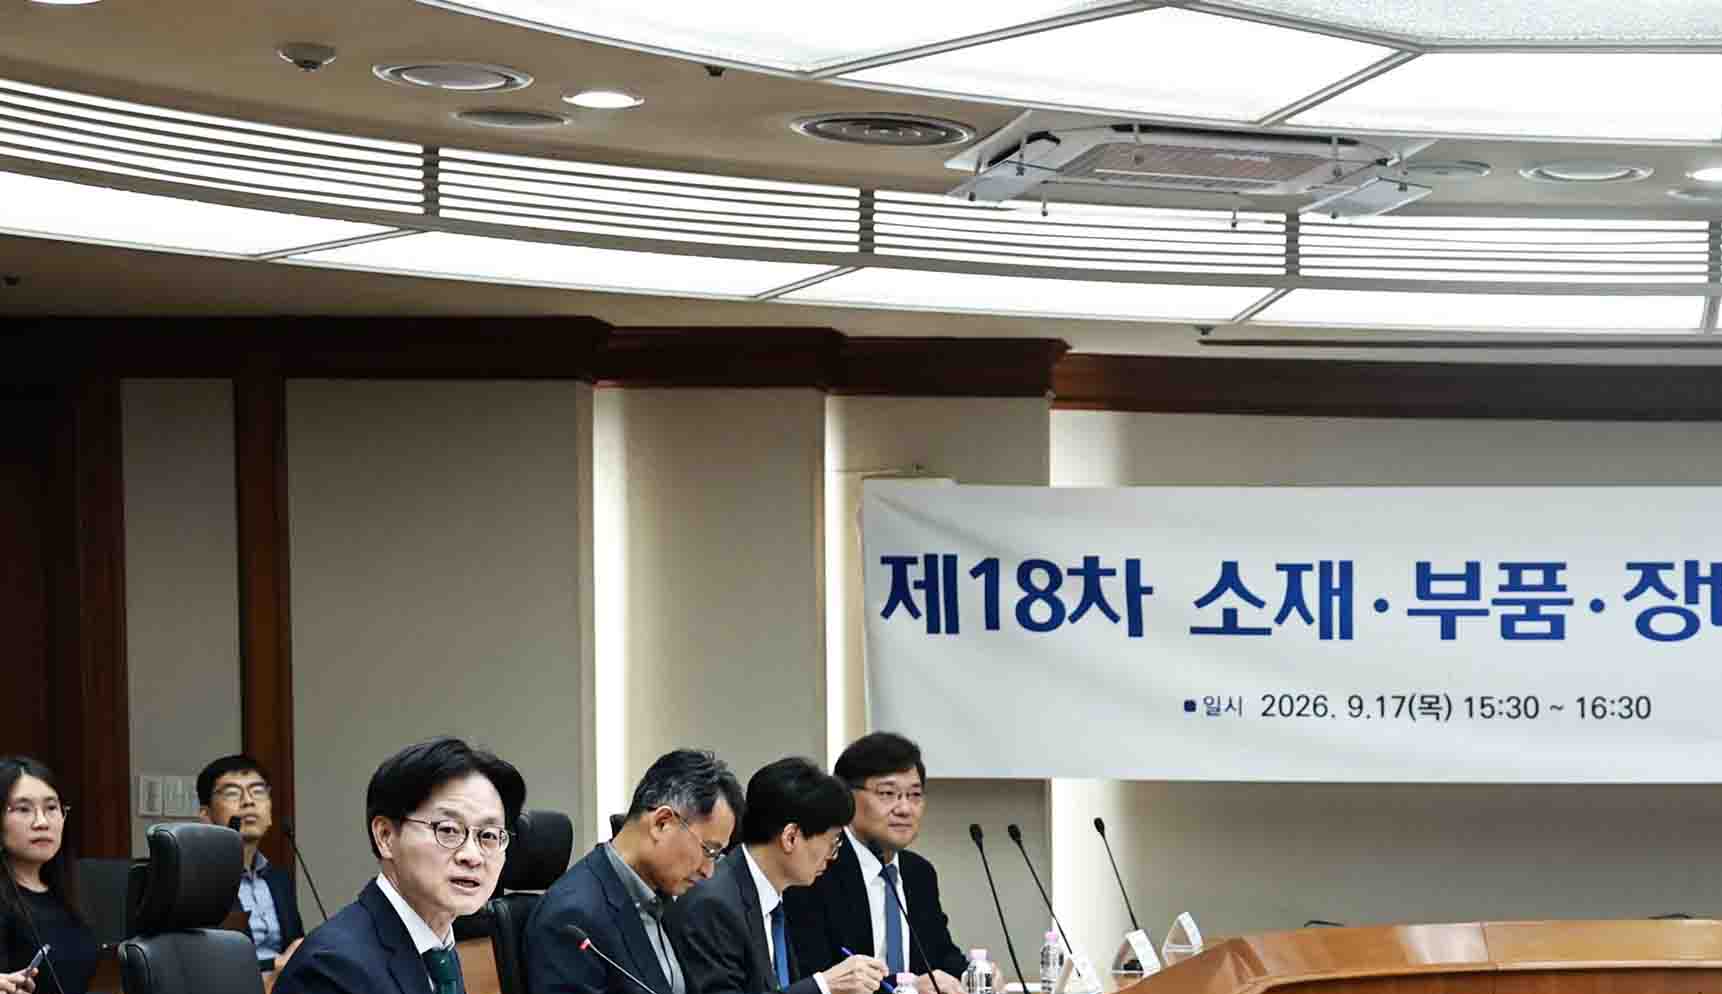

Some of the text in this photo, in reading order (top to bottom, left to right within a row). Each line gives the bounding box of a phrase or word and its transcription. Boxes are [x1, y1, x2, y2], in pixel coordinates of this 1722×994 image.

[879, 552, 1154, 638] 제18차
[1203, 695, 1243, 717] 일시
[1261, 694, 1337, 719] 2026.
[1347, 693, 1454, 721] 9.17(목)
[1464, 695, 1540, 720] 15:30
[1576, 695, 1652, 720] 16:30
